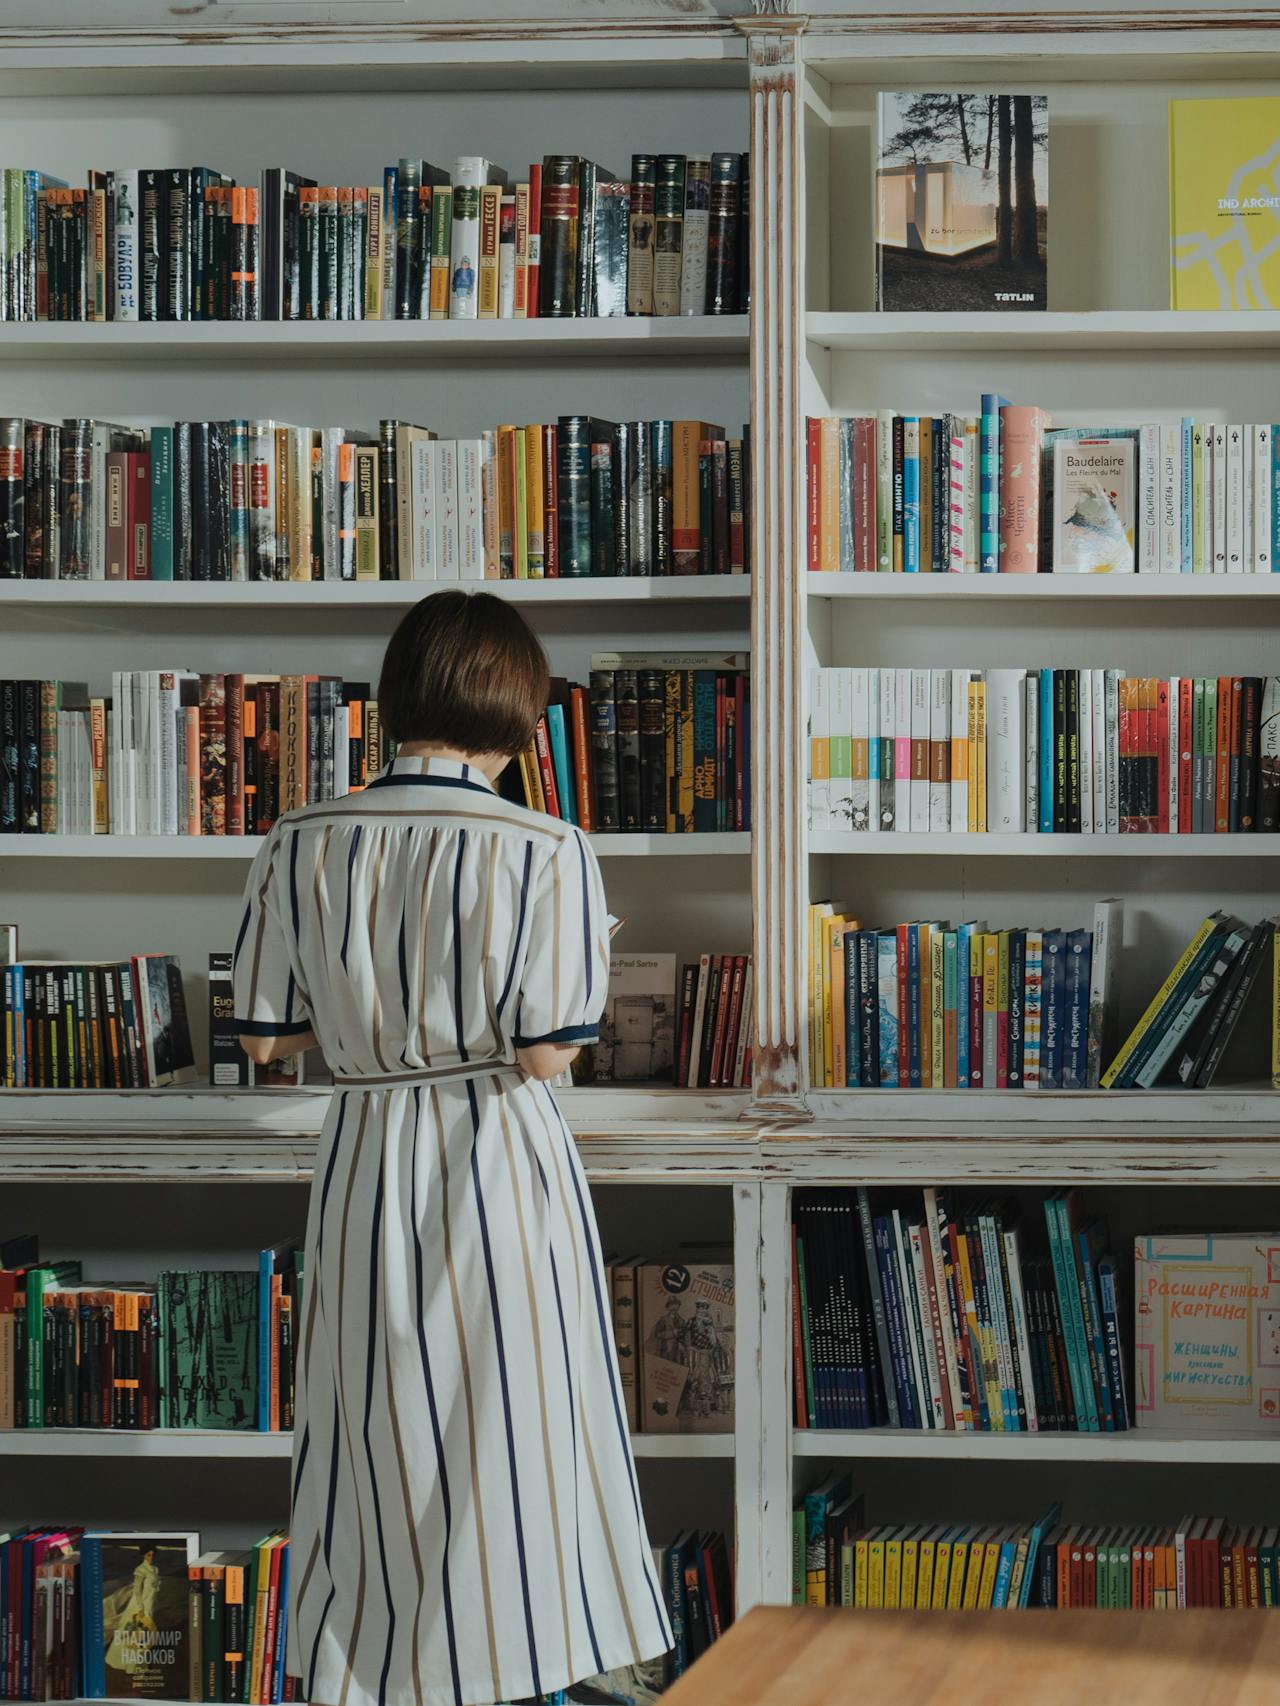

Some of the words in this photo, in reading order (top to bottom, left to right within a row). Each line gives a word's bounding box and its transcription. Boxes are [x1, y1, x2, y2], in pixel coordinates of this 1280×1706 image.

[369, 196, 379, 236] ВОННЕГУТ
[484, 196, 495, 225] ГЕССЕ
[516, 193, 527, 230] ГОЛДИНГ
[1217, 198, 1240, 209] IND
[369, 237, 379, 257] КУРТ
[486, 226, 495, 254] ГЕРМАН
[116, 240, 133, 290] БОВУАР
[359, 456, 371, 493] ХЕЛЛЕР
[730, 450, 740, 480] МОЭМ
[1065, 469, 1079, 477] Les
[1078, 468, 1099, 477] Fleurs
[1100, 468, 1109, 477] du
[1109, 468, 1121, 477] Mal
[1066, 455, 1125, 468] Baudelaire
[894, 473, 904, 512] МИНГЮ
[894, 513, 903, 532] ПАК
[1005, 499, 1016, 530] Мисс
[1015, 495, 1026, 537] Черити
[1, 685, 13, 711] ОСТИН
[24, 686, 34, 711] ОСТИН
[704, 683, 716, 715] ДЕТИ
[3, 711, 14, 737] ДЖЕЙН
[24, 711, 35, 737] ДЖЕЙН
[92, 709, 103, 740] РЕМАРК
[367, 710, 378, 744] УАЙЛЬД
[704, 717, 715, 750] ОТЦА
[1266, 722, 1278, 751] ПАКС
[367, 744, 378, 771] ОСКАР
[694, 765, 705, 799] АРНО
[704, 756, 715, 800] ШМИДТ
[635, 959, 659, 969] Sartre
[1028, 975, 1039, 1016] КИМКА
[665, 1268, 687, 1289] 12
[688, 1279, 736, 1306] СТУЛЬЕВ
[670, 1553, 680, 1608] Сибирочка
[113, 1629, 183, 1648] ВЛАДИМИР
[120, 1648, 176, 1665] НАБОКОВ
